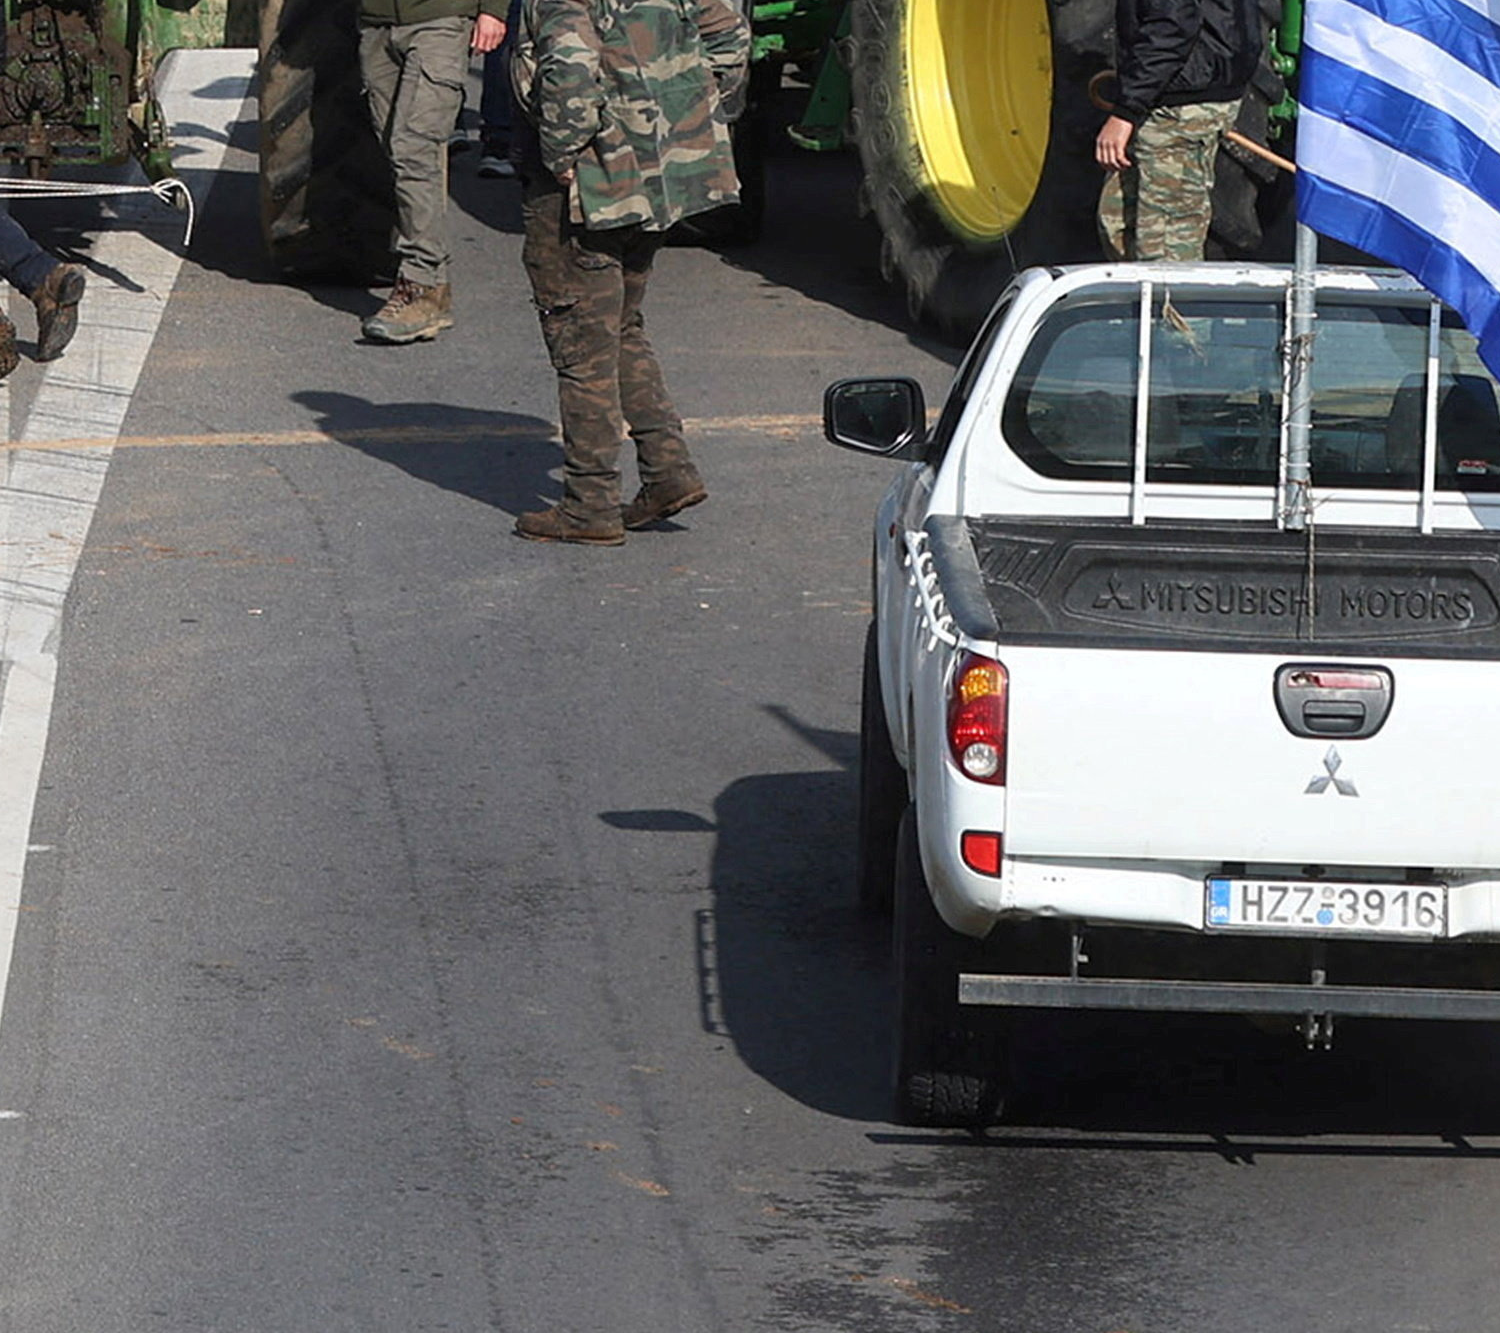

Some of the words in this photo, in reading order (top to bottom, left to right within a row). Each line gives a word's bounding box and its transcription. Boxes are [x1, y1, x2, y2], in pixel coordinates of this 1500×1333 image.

[1140, 581, 1320, 619] MITSUBISHI
[1341, 587, 1474, 622] MOTORS
[1211, 905, 1228, 918] GR
